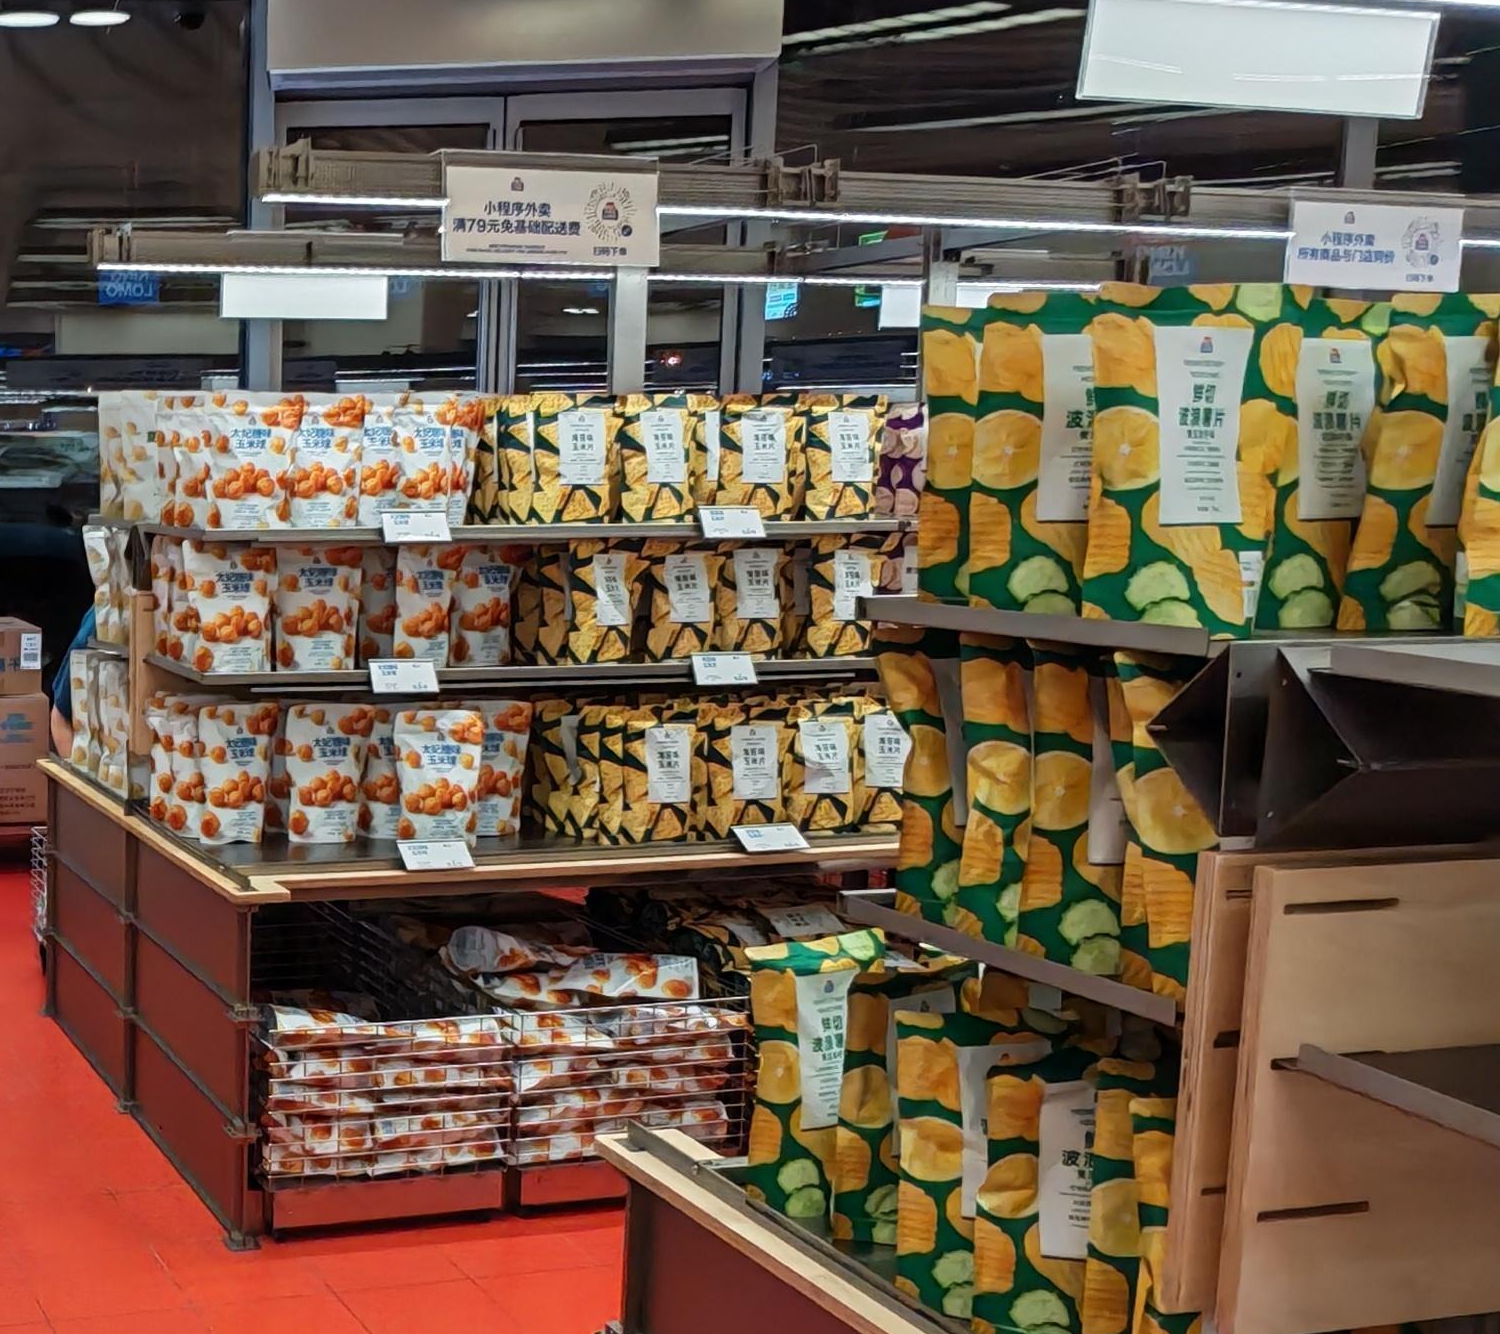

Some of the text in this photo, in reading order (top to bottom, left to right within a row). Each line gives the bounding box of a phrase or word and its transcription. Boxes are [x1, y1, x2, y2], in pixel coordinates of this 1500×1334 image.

[483, 200, 553, 217] 小程序外卖
[452, 217, 582, 236] 满79元免基础配送费
